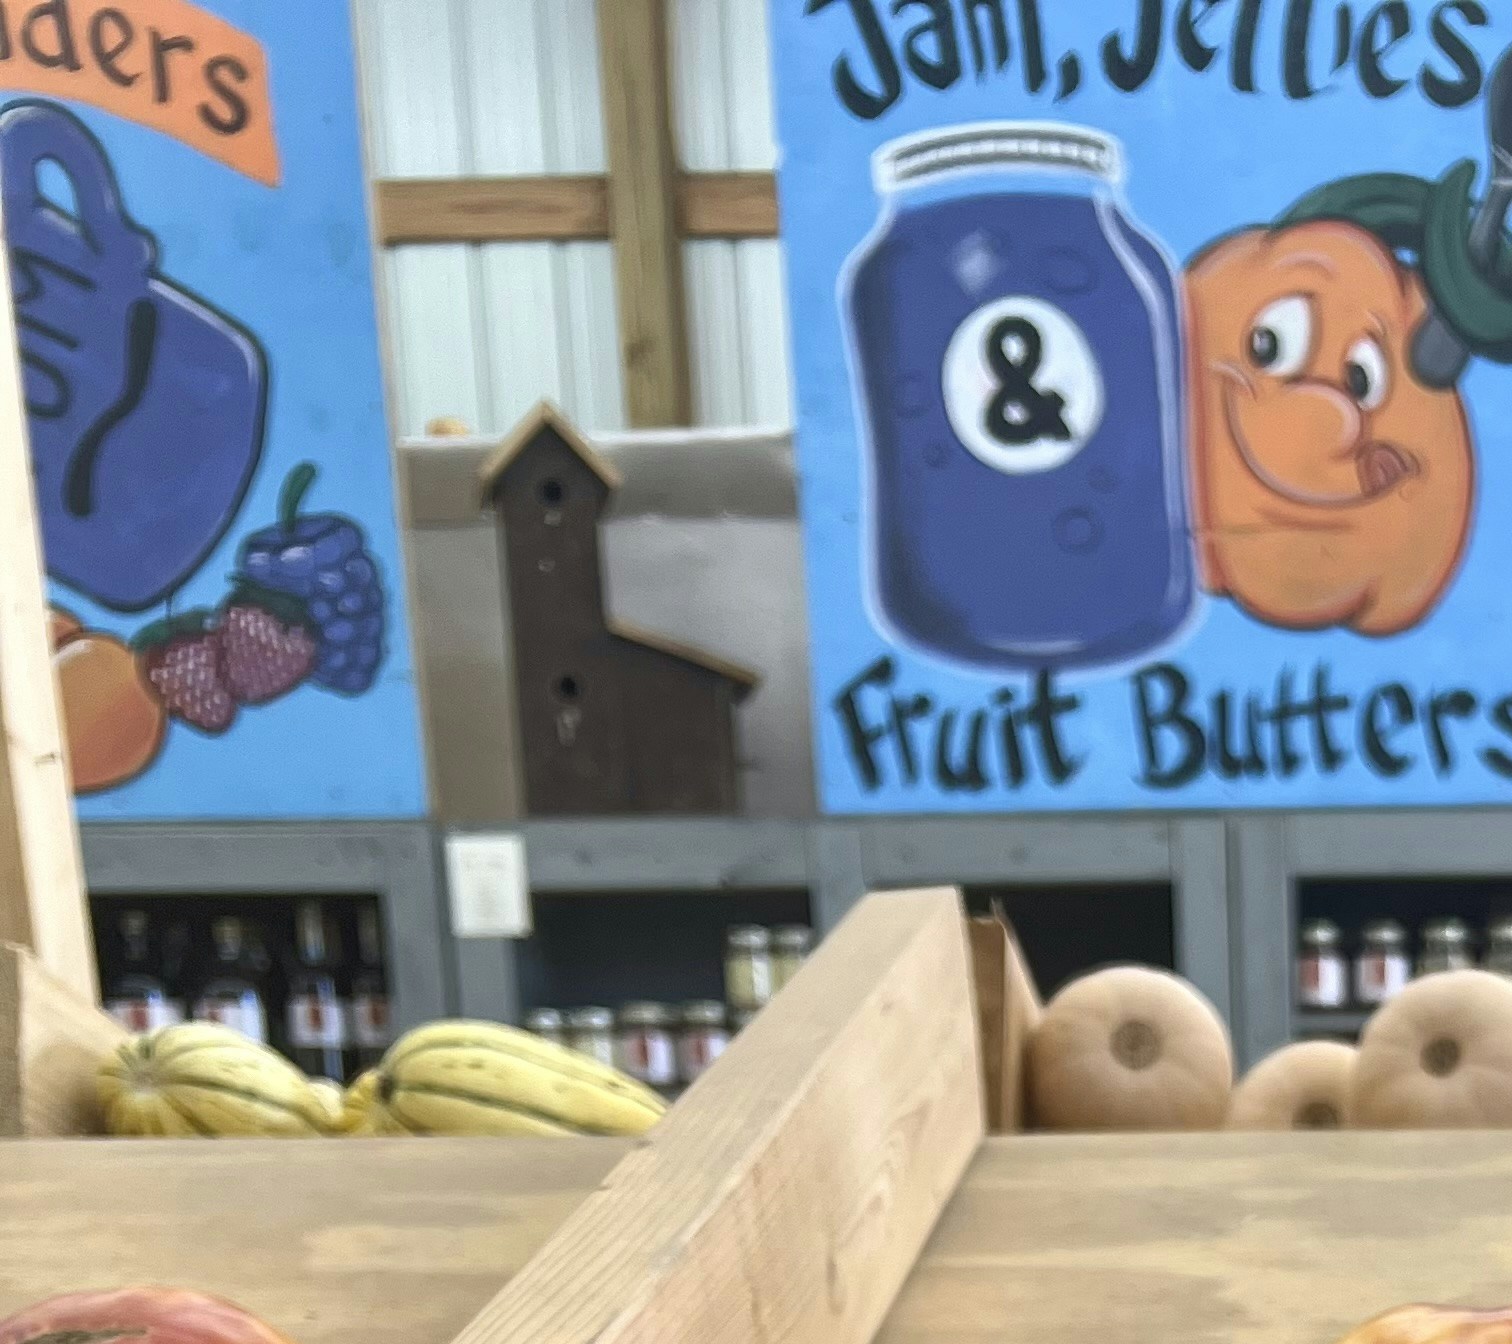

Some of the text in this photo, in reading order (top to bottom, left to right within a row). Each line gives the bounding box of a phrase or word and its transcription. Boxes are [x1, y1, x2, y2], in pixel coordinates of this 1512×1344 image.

[0, 0, 250, 135] ders
[802, 0, 1488, 120] Jam, Jellies
[985, 315, 1072, 446] &
[834, 656, 1084, 794] Fruit
